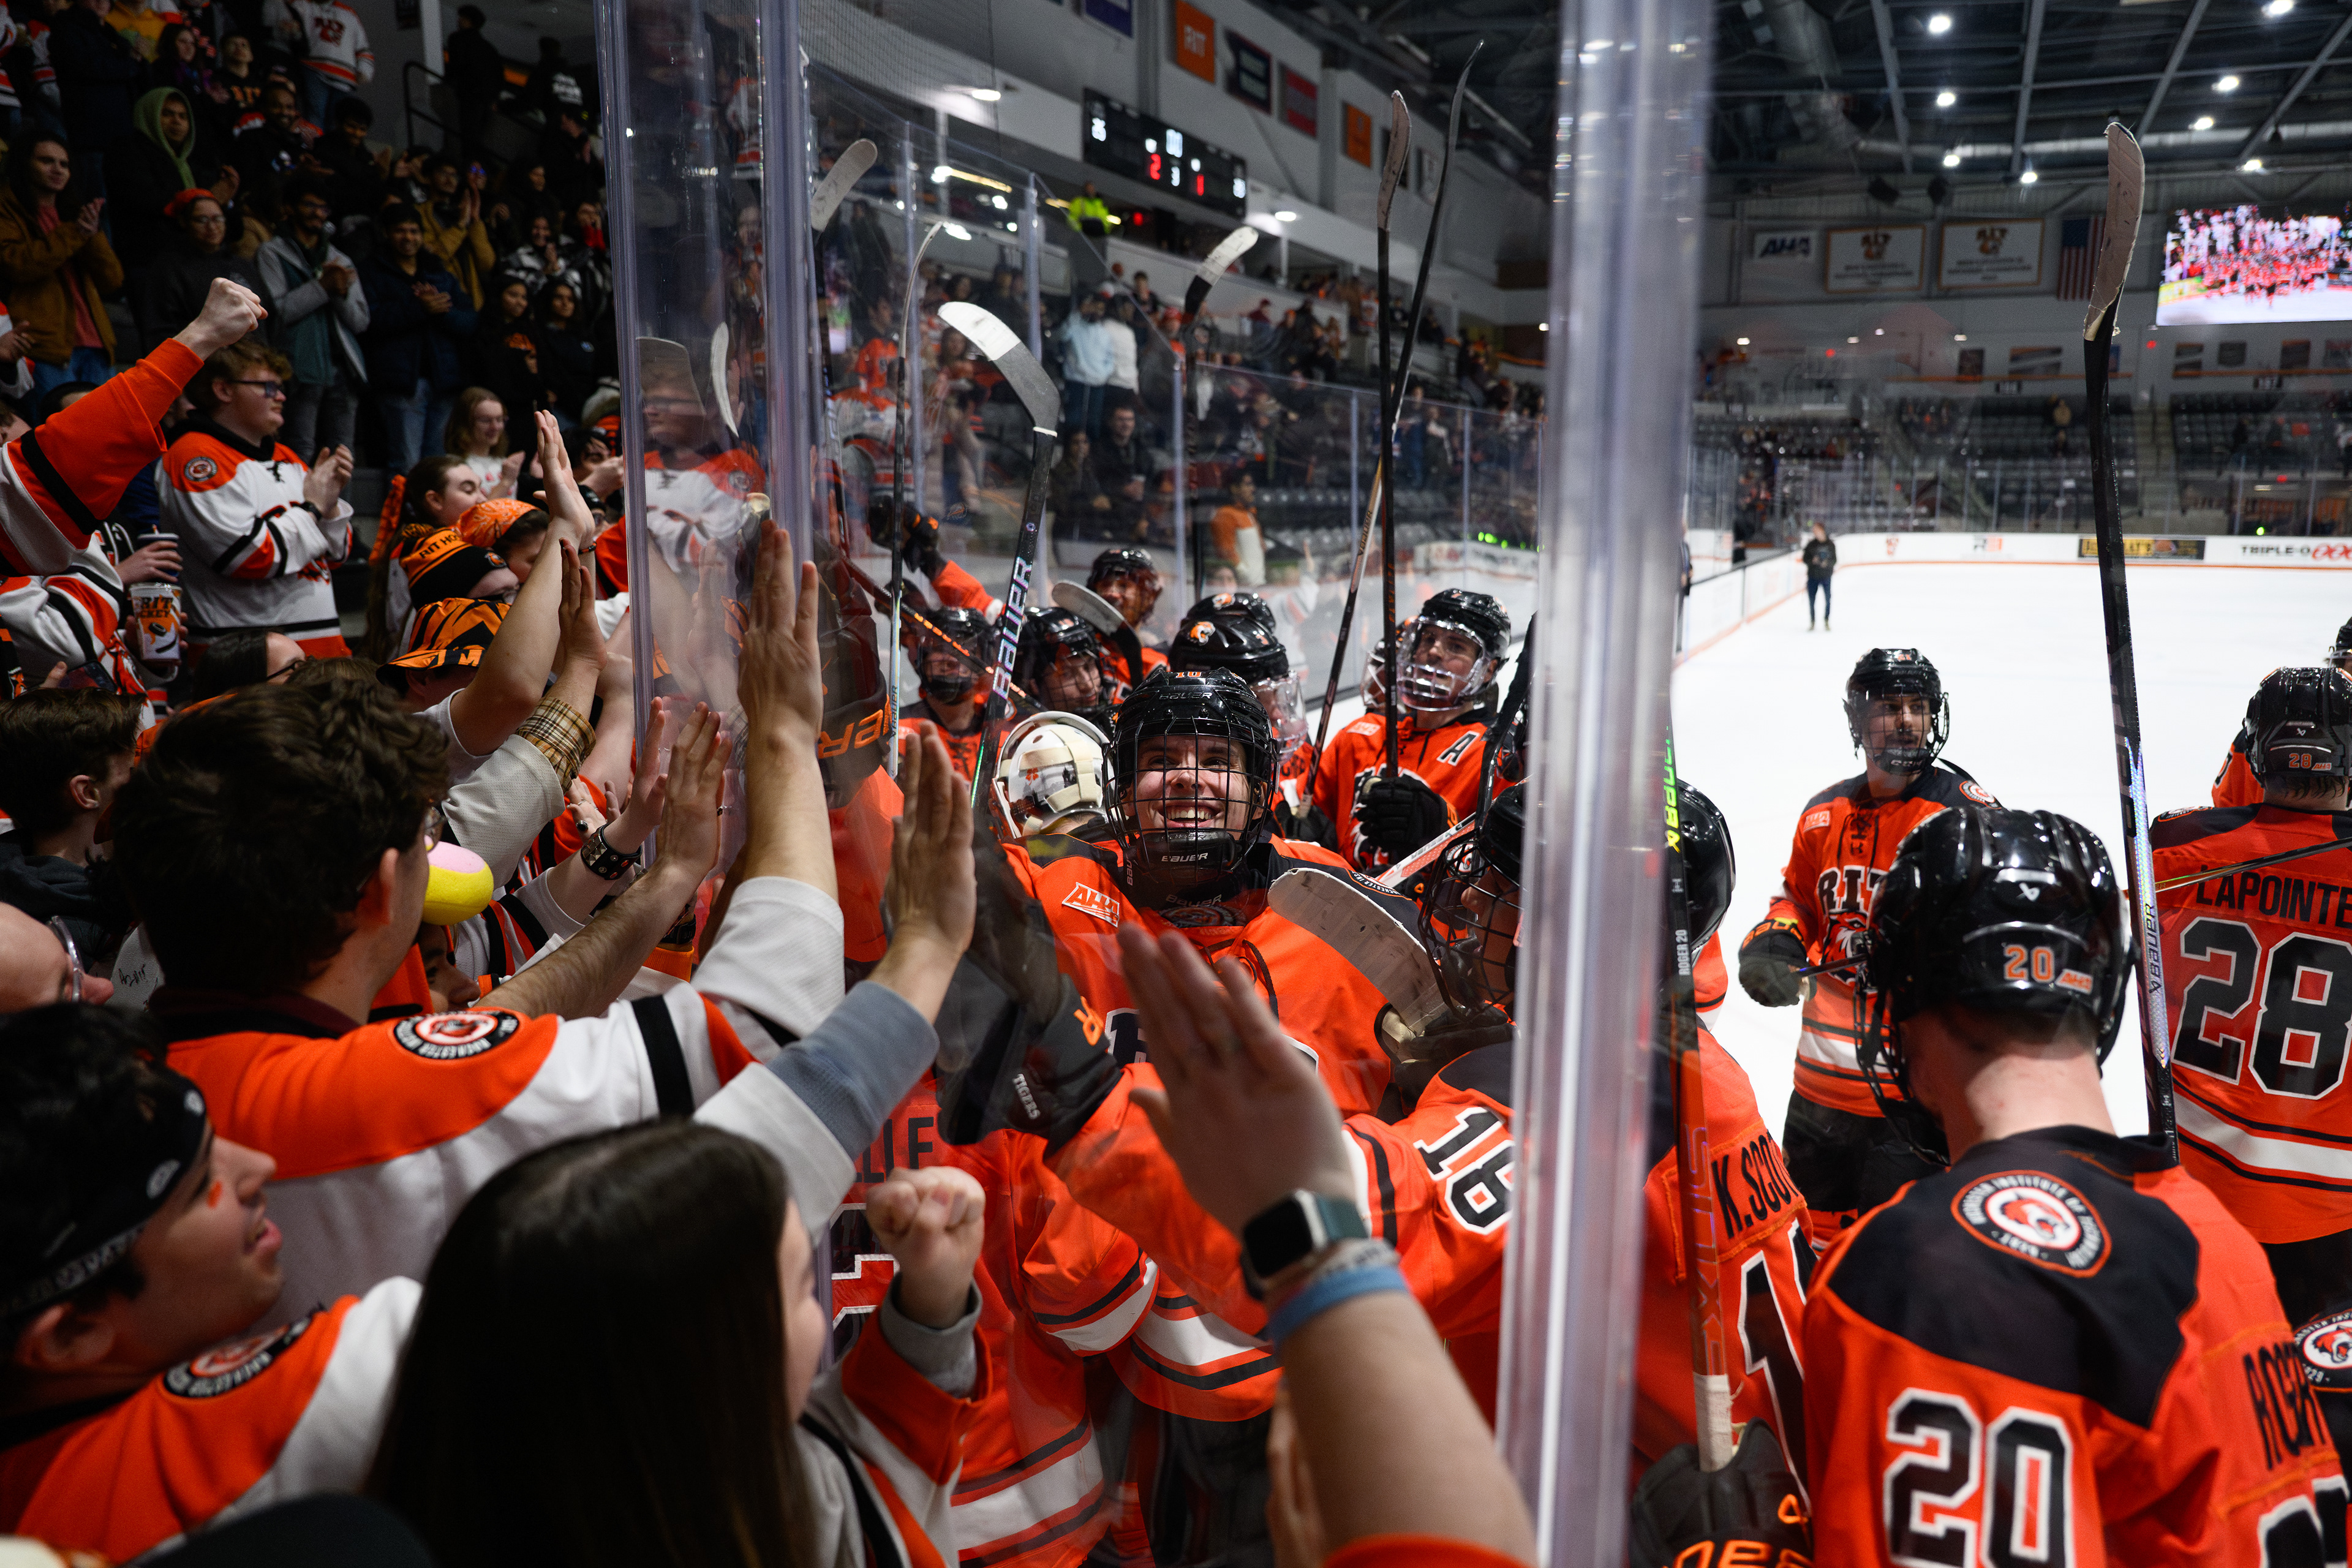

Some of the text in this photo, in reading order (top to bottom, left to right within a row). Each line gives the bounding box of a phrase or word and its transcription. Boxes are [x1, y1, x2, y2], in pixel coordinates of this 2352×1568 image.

[1150, 154, 1161, 180] 2
[1196, 173, 1204, 196] 1
[419, 541, 439, 559] RIT
[140, 595, 173, 609] RIT
[992, 556, 1032, 700] BAUER
[1159, 692, 1212, 700] BAUER
[1437, 731, 1480, 766] A
[2288, 753, 2312, 769] 28
[1161, 852, 1208, 862] BAUER
[1066, 884, 1120, 916] AHA
[1165, 894, 1223, 907] BAUER
[2195, 865, 2352, 931] LAPOINTE
[1675, 929, 1692, 976] ROGER 20
[2144, 903, 2162, 981] BAUER
[2003, 944, 2056, 983] 20
[2171, 916, 2352, 1100] 28
[1012, 1074, 1040, 1120] TIGERS
[1882, 1386, 2076, 1568] 20
